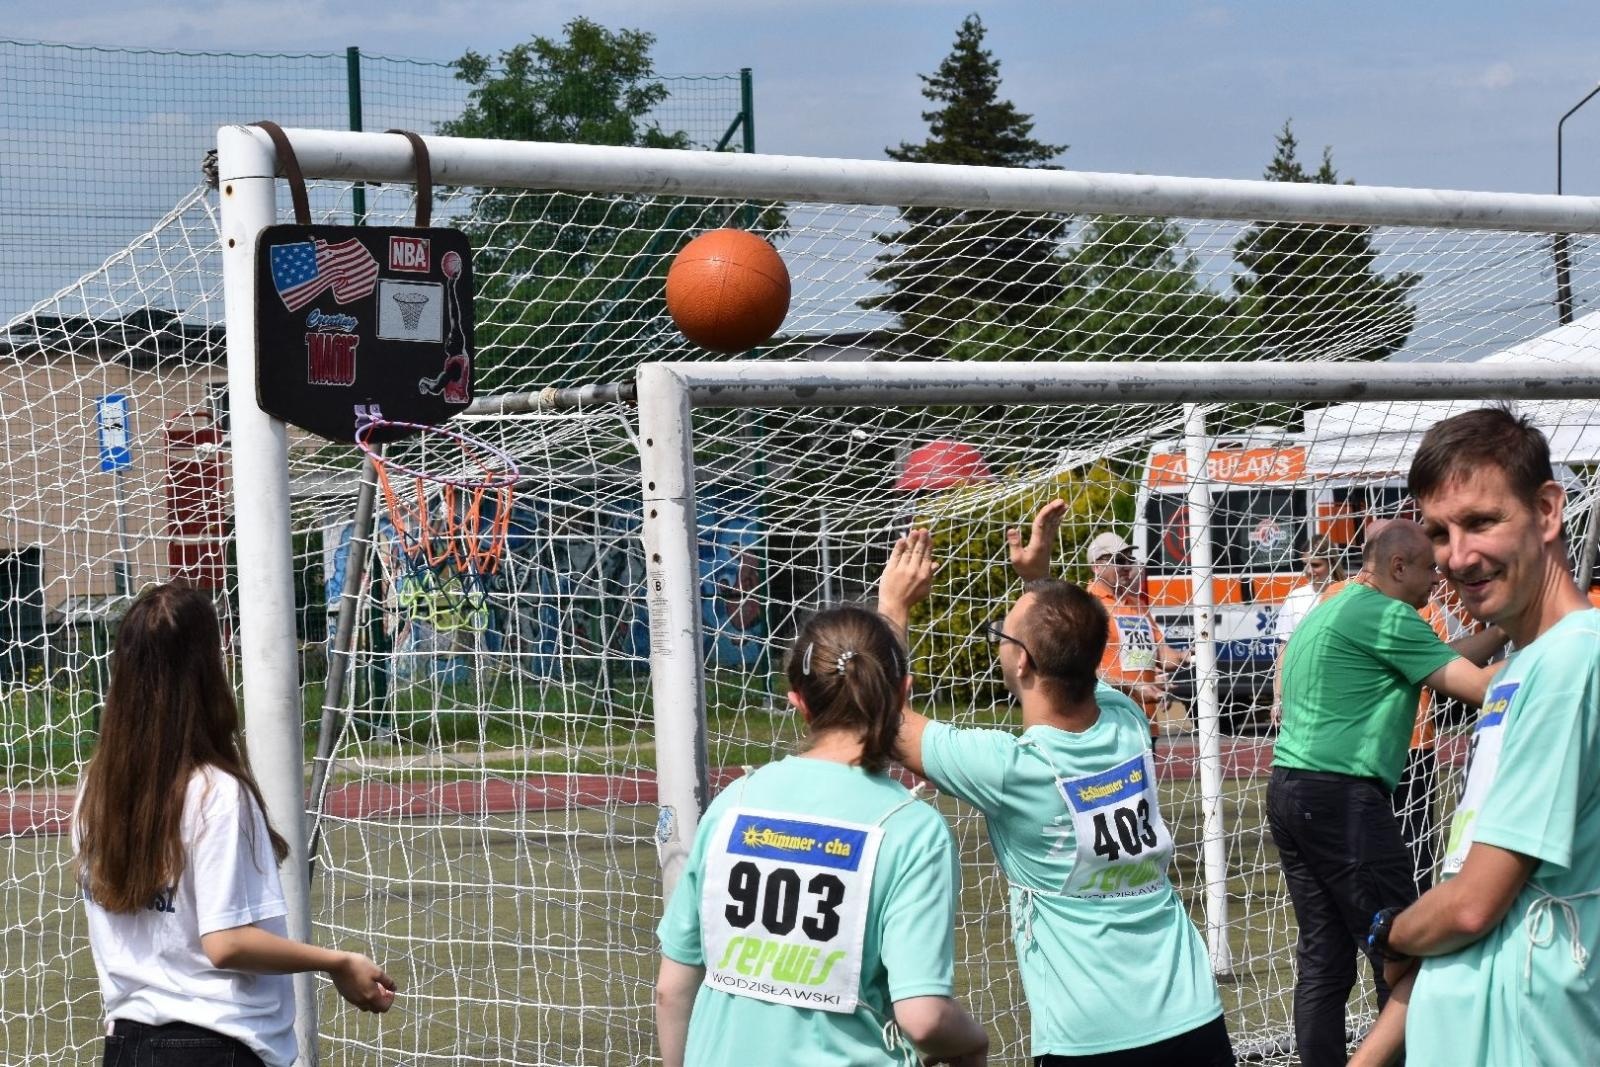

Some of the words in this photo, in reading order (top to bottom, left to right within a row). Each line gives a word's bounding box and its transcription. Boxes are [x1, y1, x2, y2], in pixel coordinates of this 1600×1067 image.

[392, 241, 427, 268] NBA
[1170, 454, 1290, 481] ABULANS
[655, 581, 662, 592] B
[1087, 779, 1123, 799] Summer
[761, 828, 816, 852] Summer
[825, 838, 852, 857] cha
[1092, 798, 1158, 862] 403
[724, 860, 846, 942] 903
[717, 936, 847, 986] serwis
[712, 971, 841, 1005] WODZISŁAWSKI
